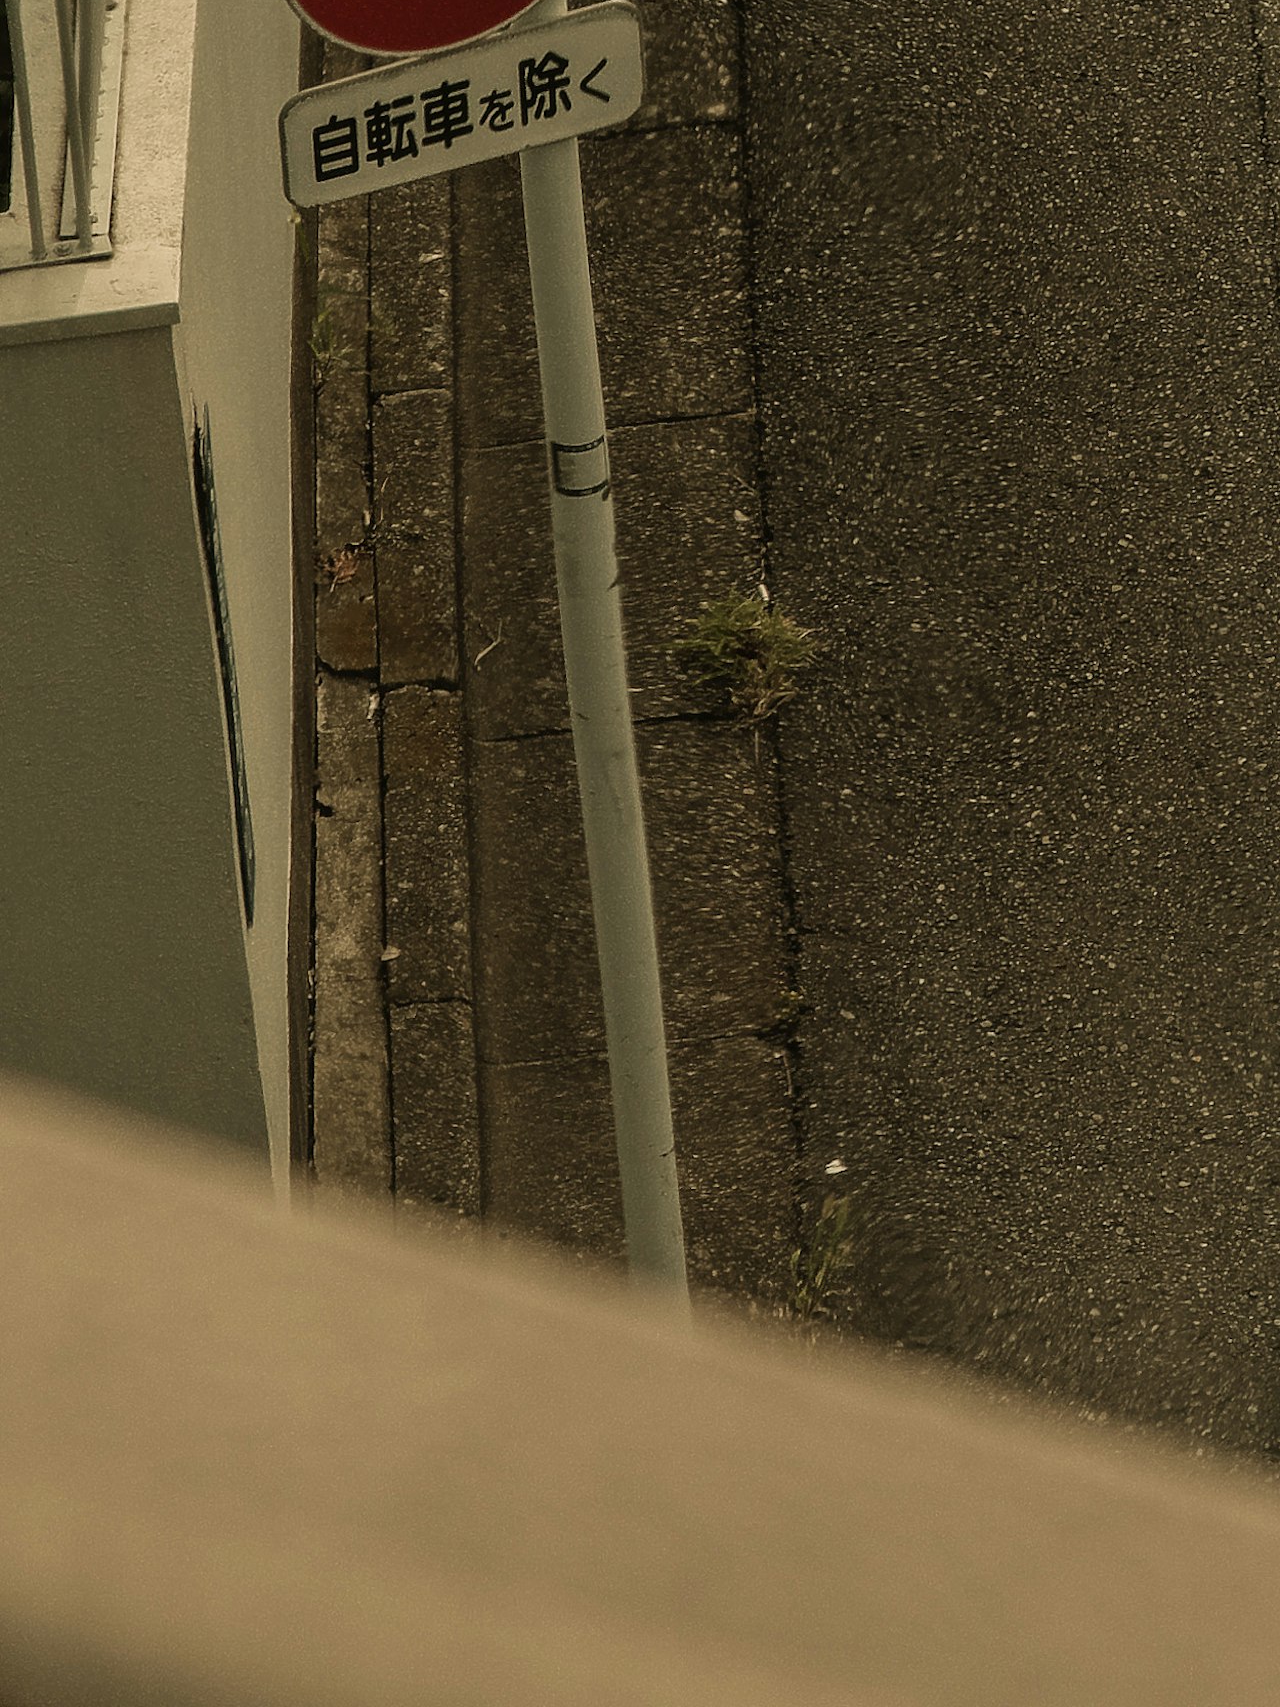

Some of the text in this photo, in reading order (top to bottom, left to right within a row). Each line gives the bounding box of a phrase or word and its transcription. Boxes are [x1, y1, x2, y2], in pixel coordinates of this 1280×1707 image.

[312, 50, 610, 184] 自転車を除く
